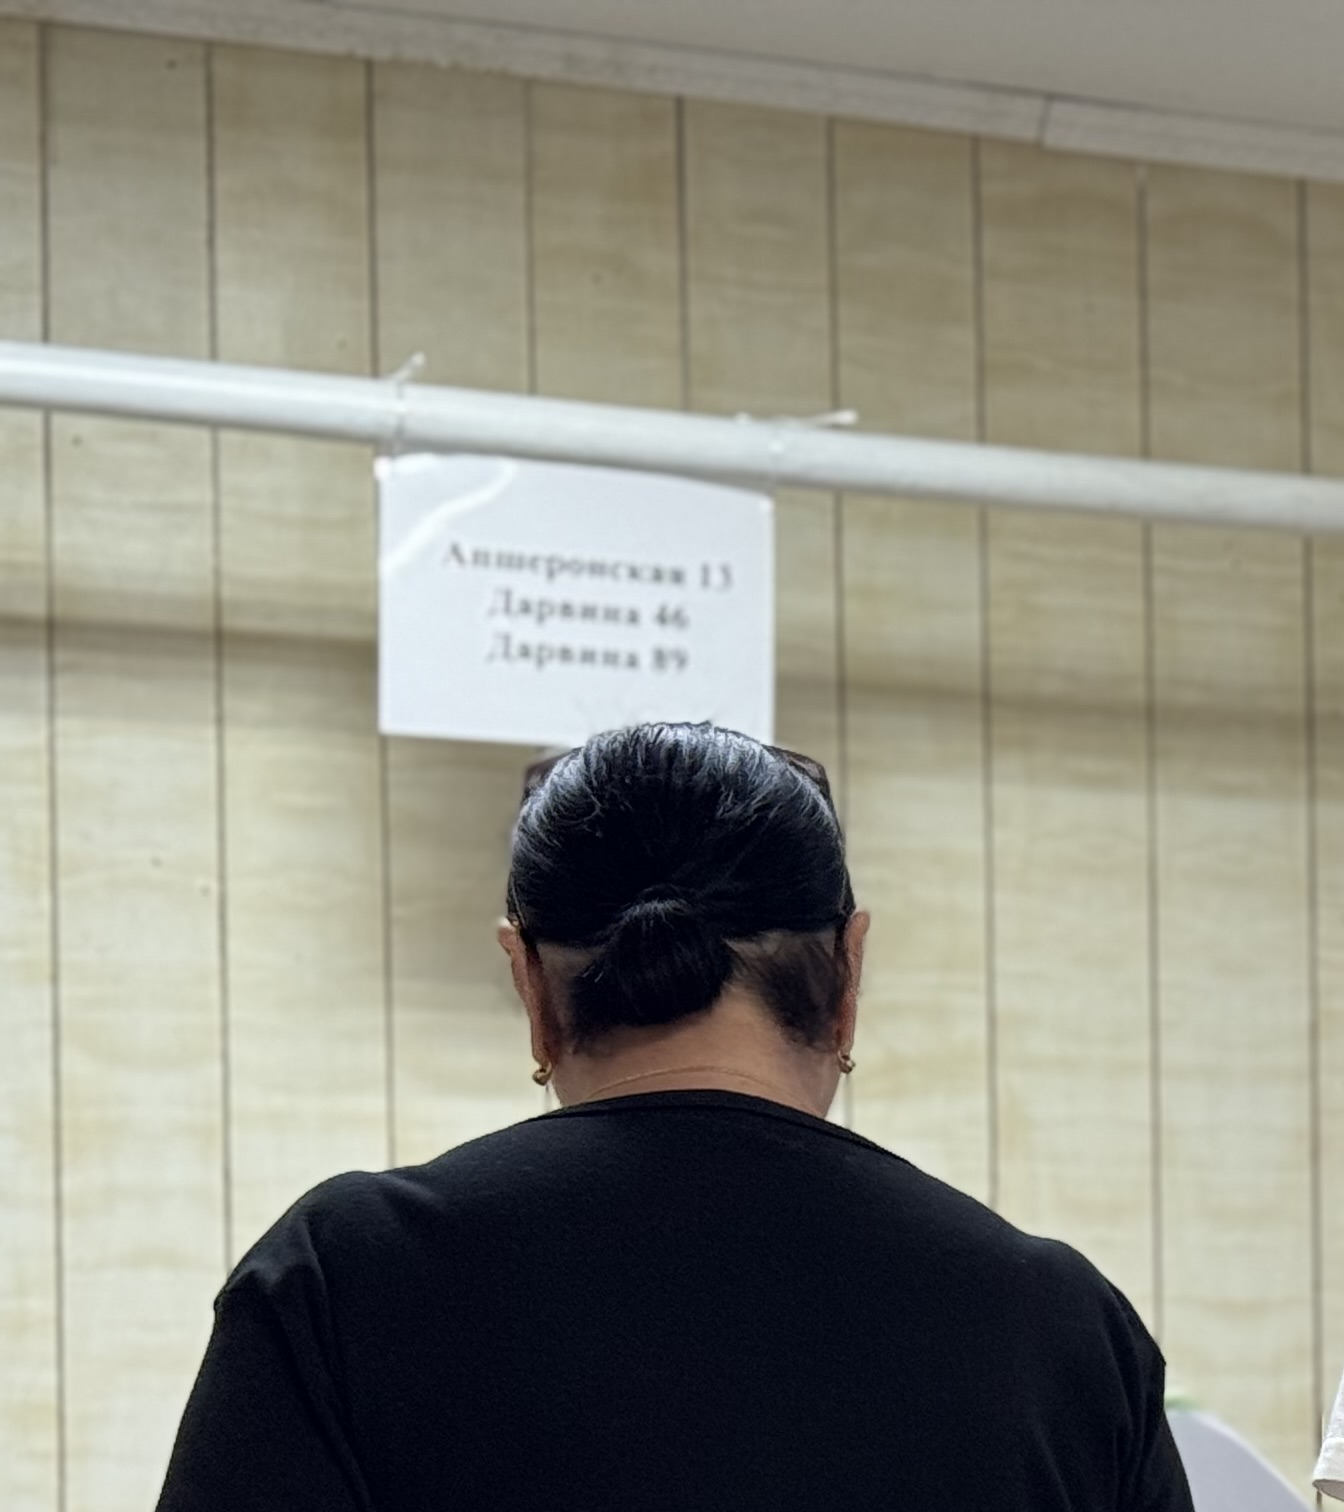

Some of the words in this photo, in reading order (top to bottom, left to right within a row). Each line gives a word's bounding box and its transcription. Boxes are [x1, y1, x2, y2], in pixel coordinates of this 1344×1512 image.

[443, 542, 686, 585] Апшеронская
[487, 587, 640, 625] Дарвина
[653, 603, 691, 631] 46
[487, 632, 640, 669] Дарвина
